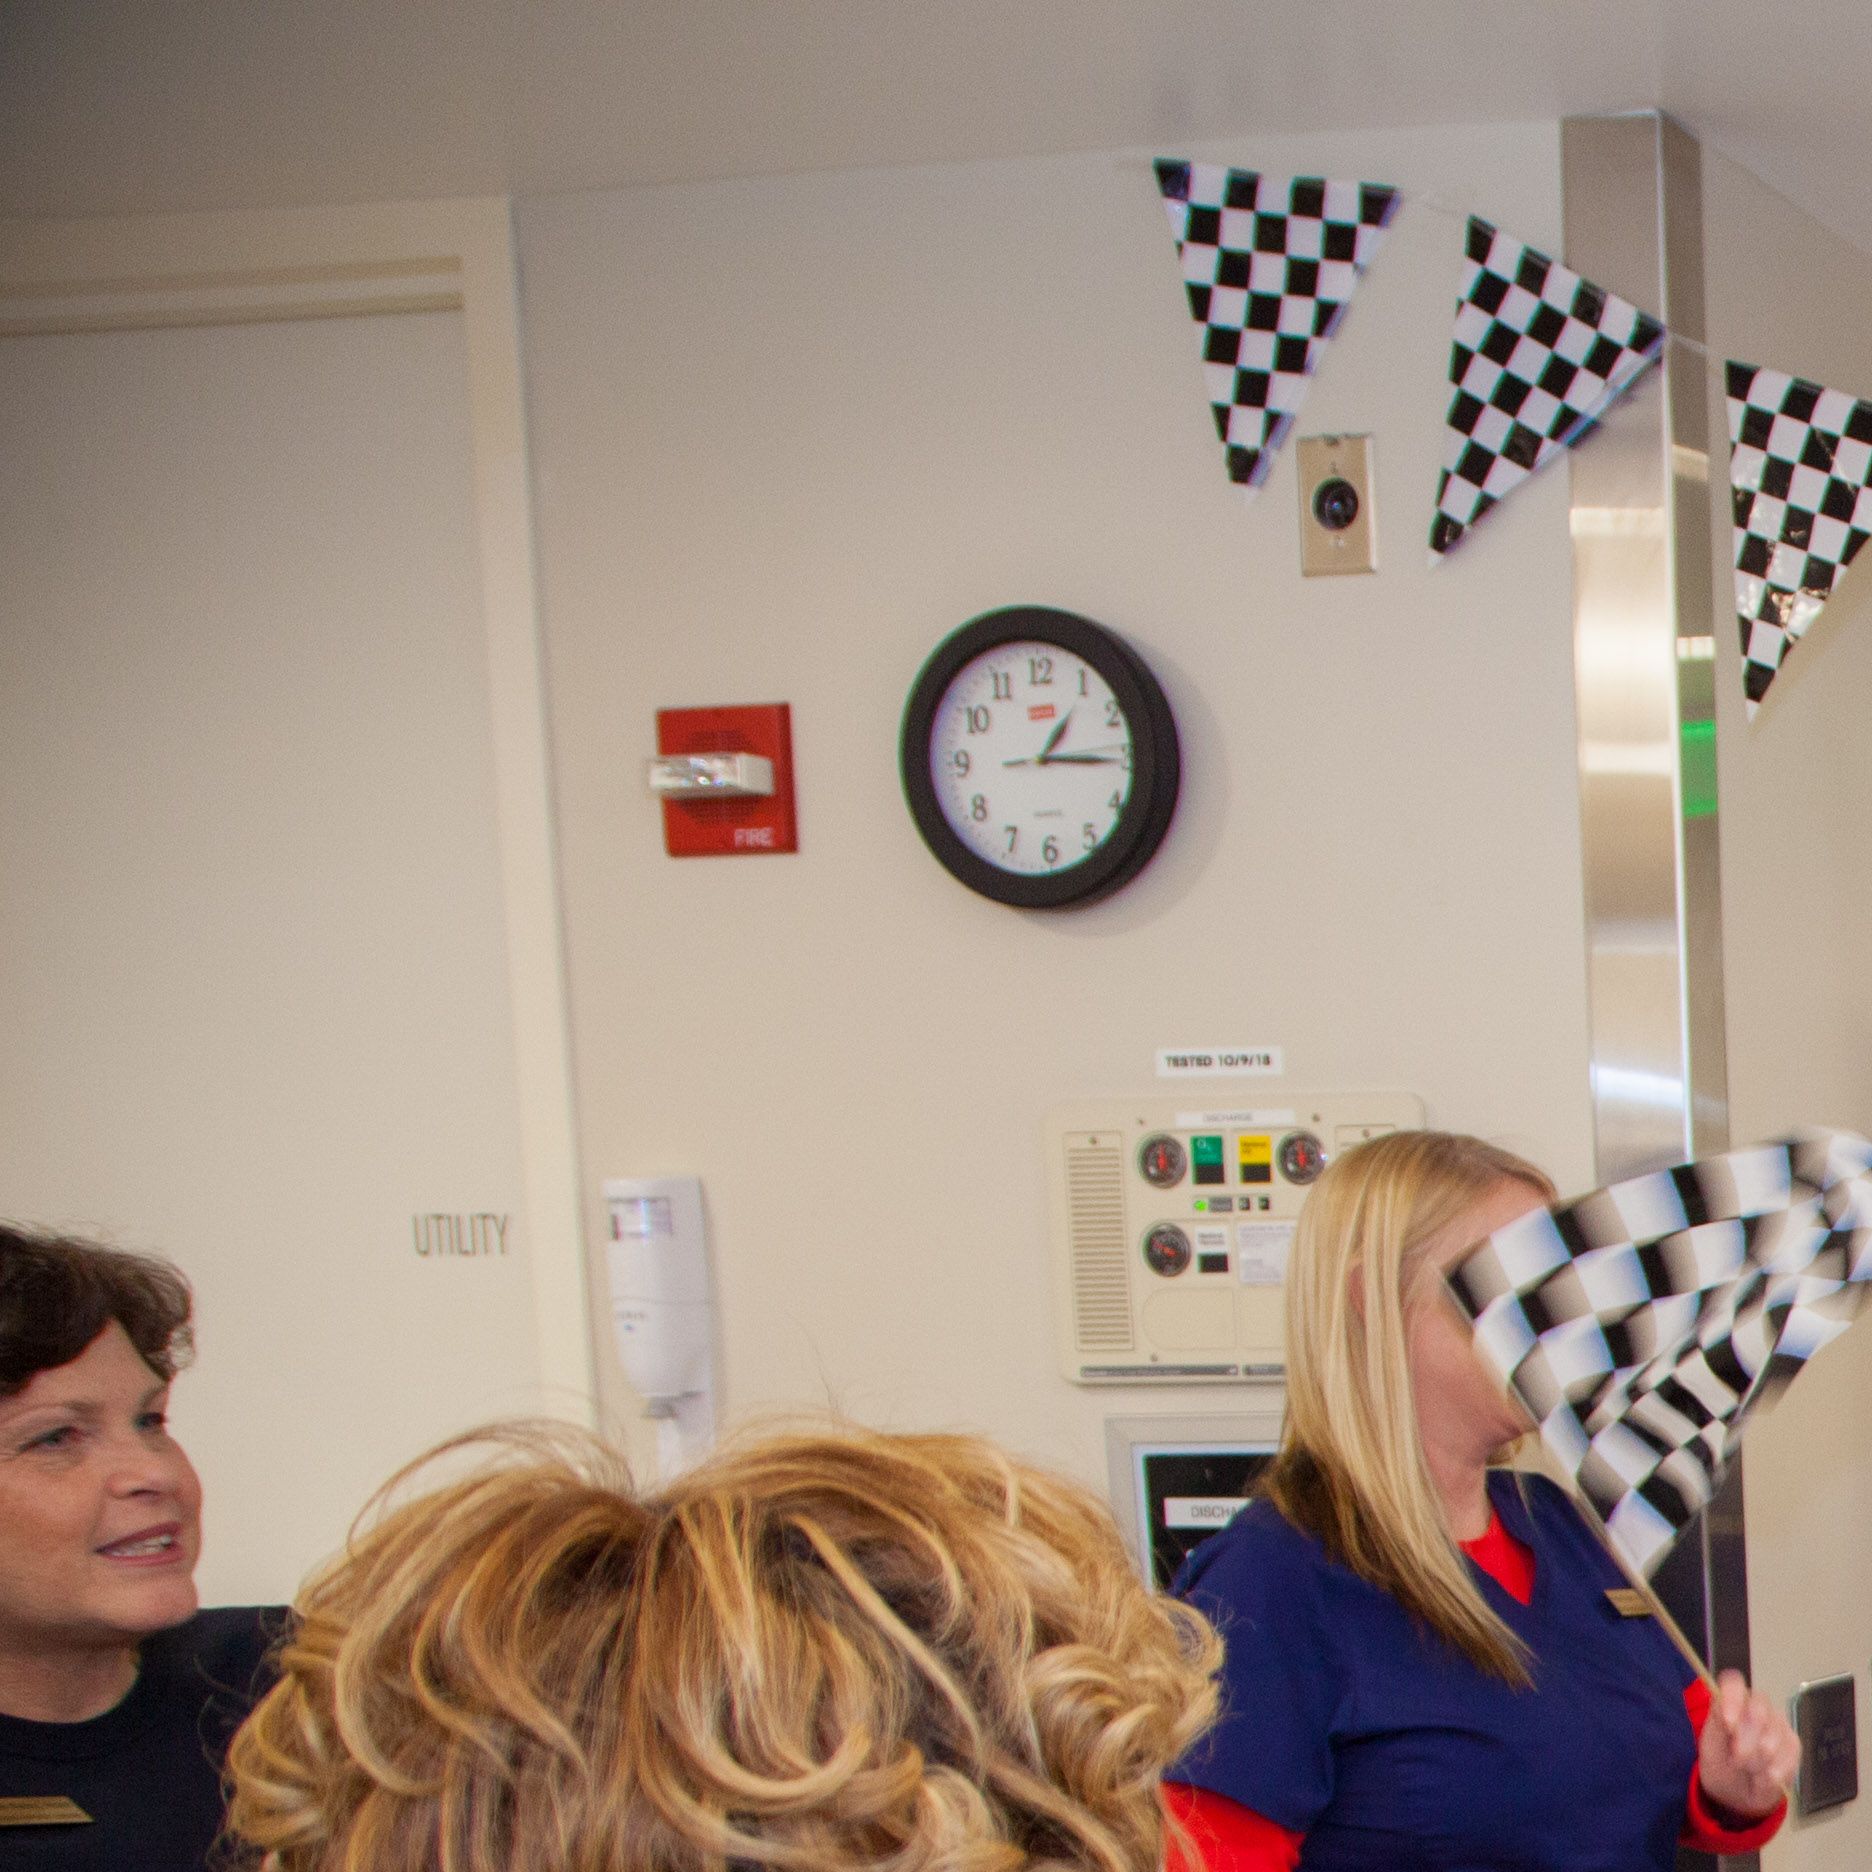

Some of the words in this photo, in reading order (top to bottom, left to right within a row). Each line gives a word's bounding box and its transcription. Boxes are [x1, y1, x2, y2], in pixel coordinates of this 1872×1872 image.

[1027, 657, 1052, 685] 12
[1077, 667, 1088, 697] 1
[991, 671, 1012, 700] 11
[966, 705, 990, 734] 10
[1105, 699, 1121, 727] 2
[953, 749, 970, 777] 9
[970, 793, 988, 821] 8
[1108, 789, 1126, 810] 4
[734, 828, 773, 847] FIRE
[1005, 825, 1018, 852] 7
[1041, 836, 1058, 863] 6
[1083, 823, 1097, 850] 5
[1165, 1054, 1213, 1068] TESTED
[411, 1212, 513, 1258] UTILITY
